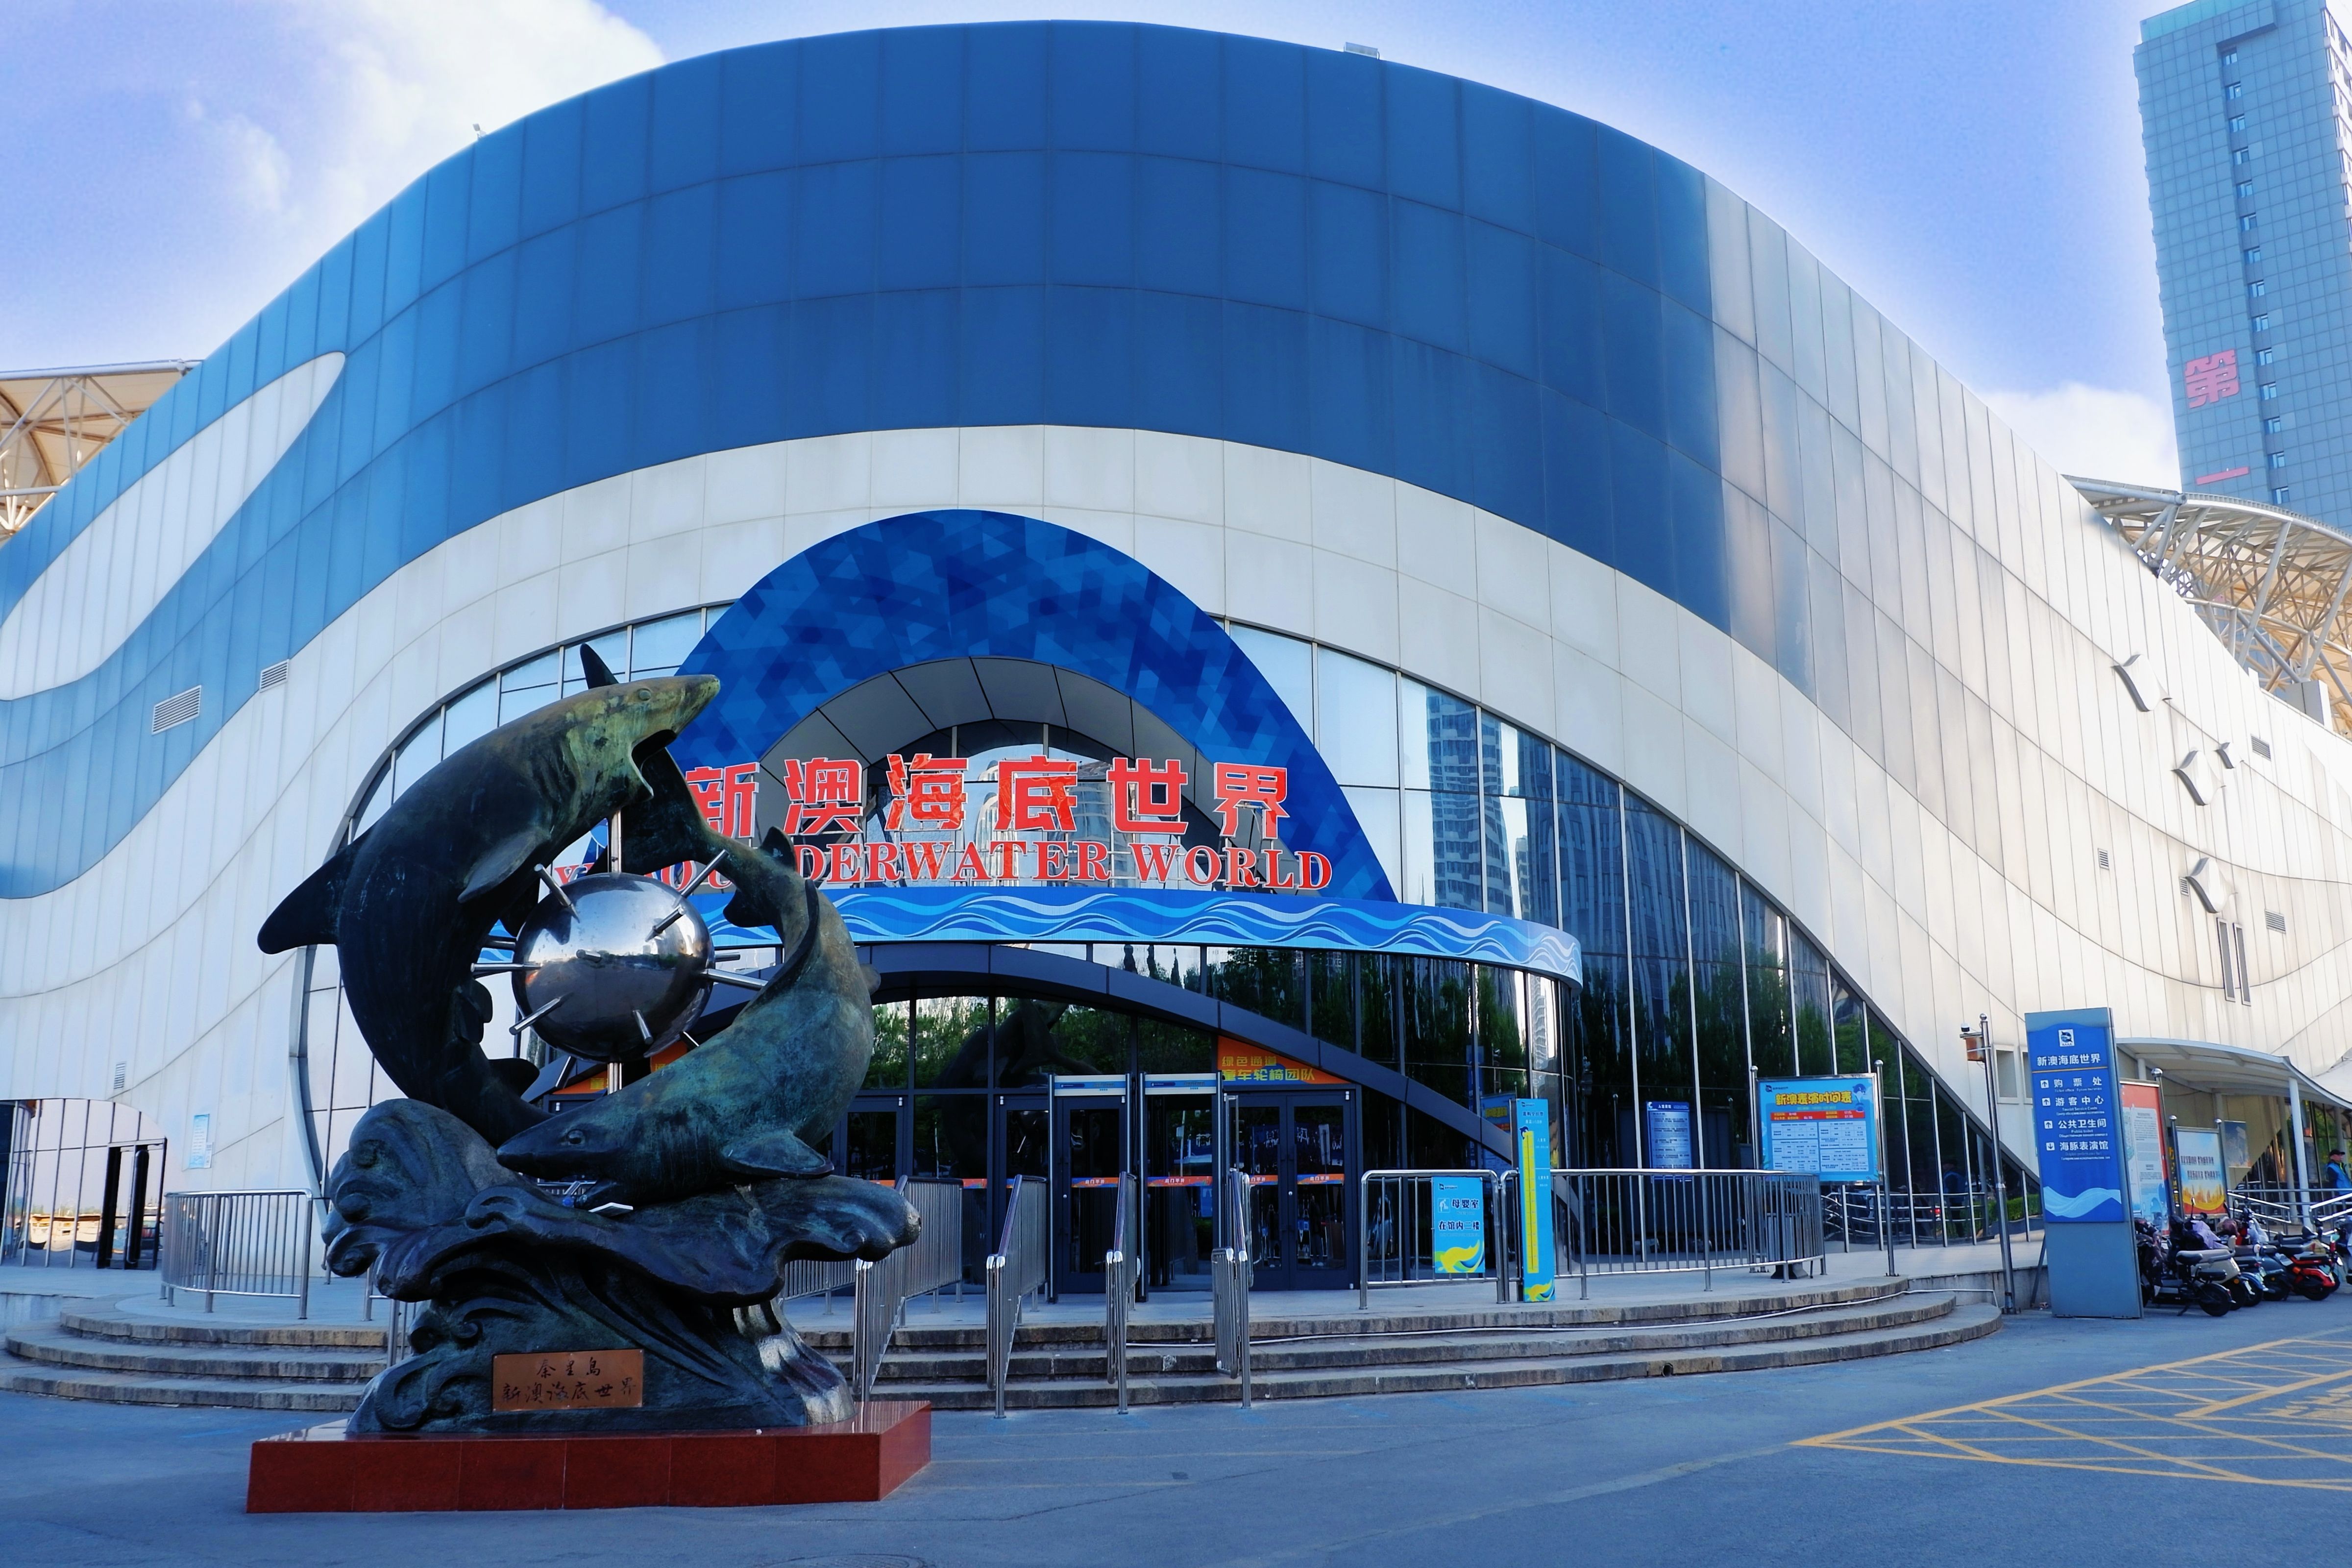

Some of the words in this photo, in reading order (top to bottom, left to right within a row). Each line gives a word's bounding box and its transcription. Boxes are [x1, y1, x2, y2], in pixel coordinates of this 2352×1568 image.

[686, 753, 1290, 839] 新澳海底世界
[708, 840, 1111, 888] DERWATER
[1128, 843, 1332, 890] WORLD
[1222, 1056, 1276, 1066] 绿色通道
[2037, 1054, 2101, 1066] 新澳海底世界
[1223, 1068, 1315, 1081] 童车轮椅团队
[2054, 1077, 2102, 1087] 购票处
[2056, 1095, 2104, 1106] 游客中心
[2058, 1119, 2107, 1128] 公共卫生间
[2060, 1141, 2108, 1151] 海豚表演馆
[1452, 1199, 1479, 1209] 母婴室
[1439, 1220, 1480, 1230] 在馆内二楼
